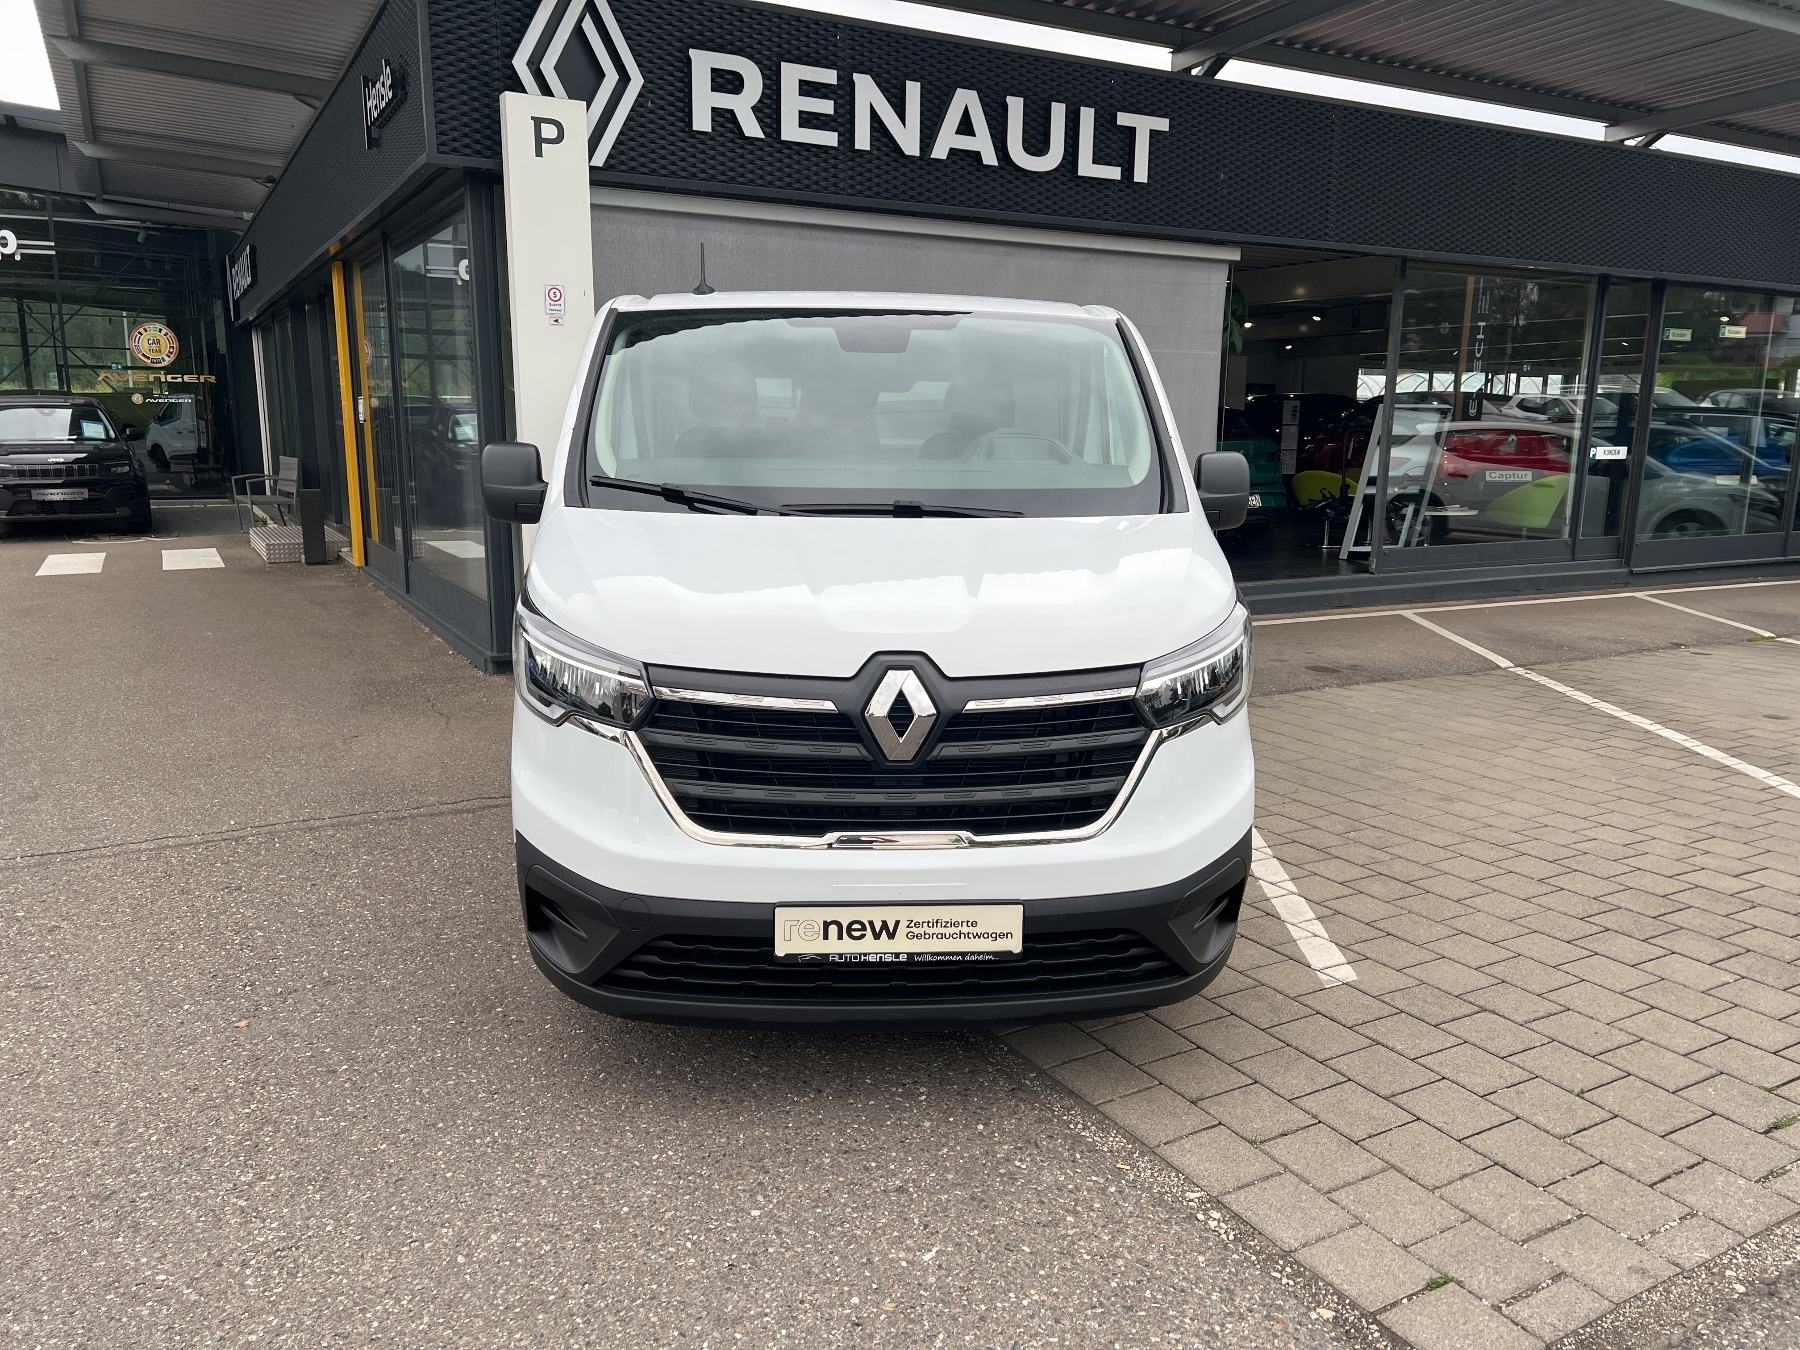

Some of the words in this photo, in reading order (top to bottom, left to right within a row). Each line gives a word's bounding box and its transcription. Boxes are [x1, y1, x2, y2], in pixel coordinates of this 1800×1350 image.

[689, 48, 1170, 184] RENAULT
[530, 115, 565, 158] P
[553, 291, 558, 299] 5
[147, 338, 161, 346] CAR
[1488, 471, 1529, 481] Captur
[905, 919, 978, 929] Zertifizierte
[783, 919, 901, 942] renew
[905, 930, 1014, 942] Gebrauchtwagen
